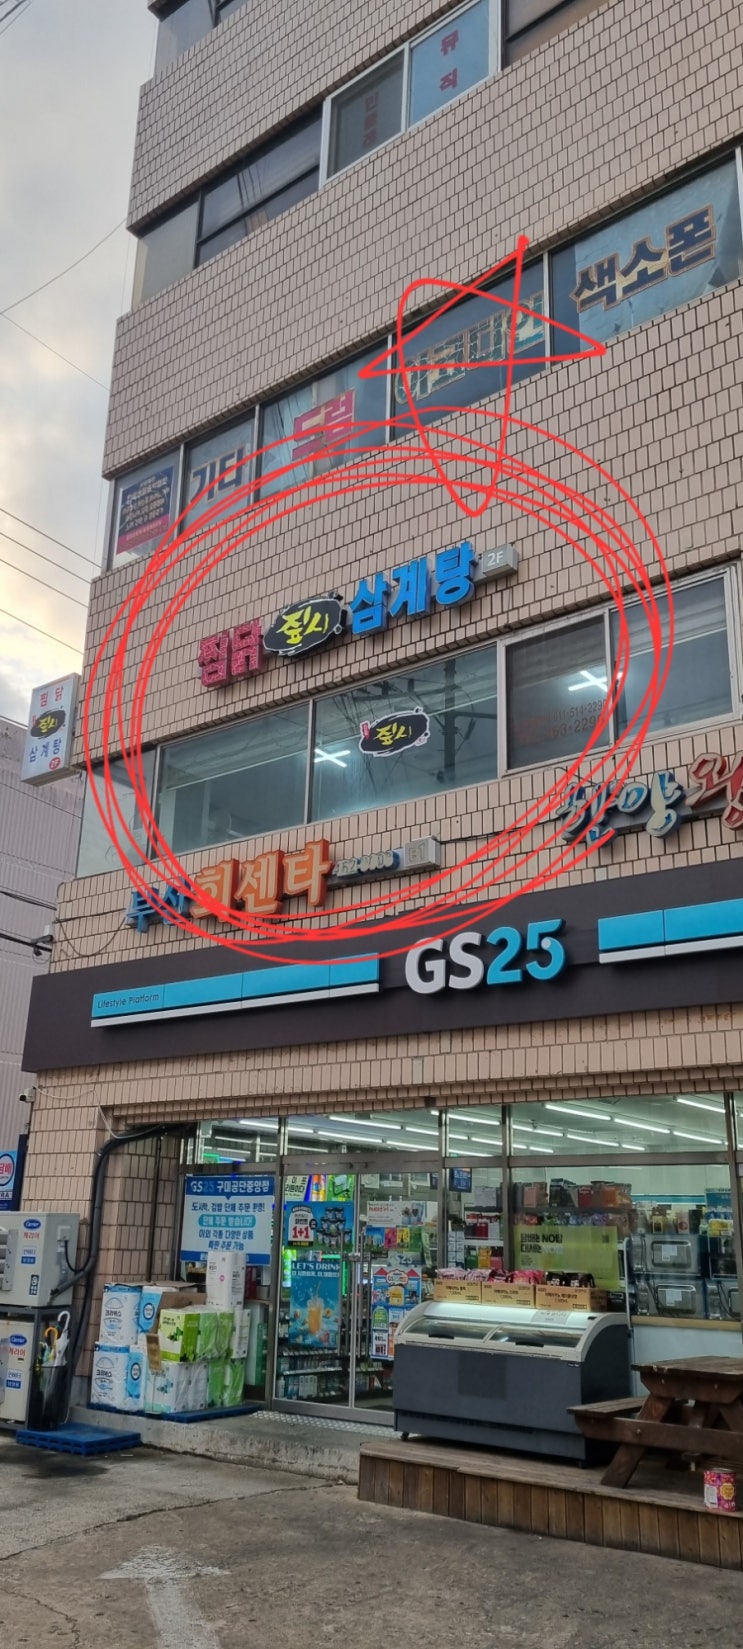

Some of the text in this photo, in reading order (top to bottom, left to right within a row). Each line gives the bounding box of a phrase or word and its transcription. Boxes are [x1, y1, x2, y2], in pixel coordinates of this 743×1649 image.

[569, 205, 716, 313] 색소폰
[292, 390, 355, 462] 드럼
[191, 443, 246, 503] 기타
[198, 618, 263, 687] 찜닭
[350, 540, 477, 635] 삼계탕
[487, 551, 505, 567] 2F
[29, 737, 62, 763] 삼계탕
[405, 918, 565, 994] GS25
[97, 993, 160, 1008] Lifestyle Platform
[190, 1180, 270, 1193] GS25 구미공단중앙점
[211, 1202, 223, 1212] 김밥
[224, 1202, 237, 1213] 단체
[238, 1202, 251, 1213] 주문
[292, 1225, 311, 1239] 1+1
[292, 1261, 314, 1270] LET'S
